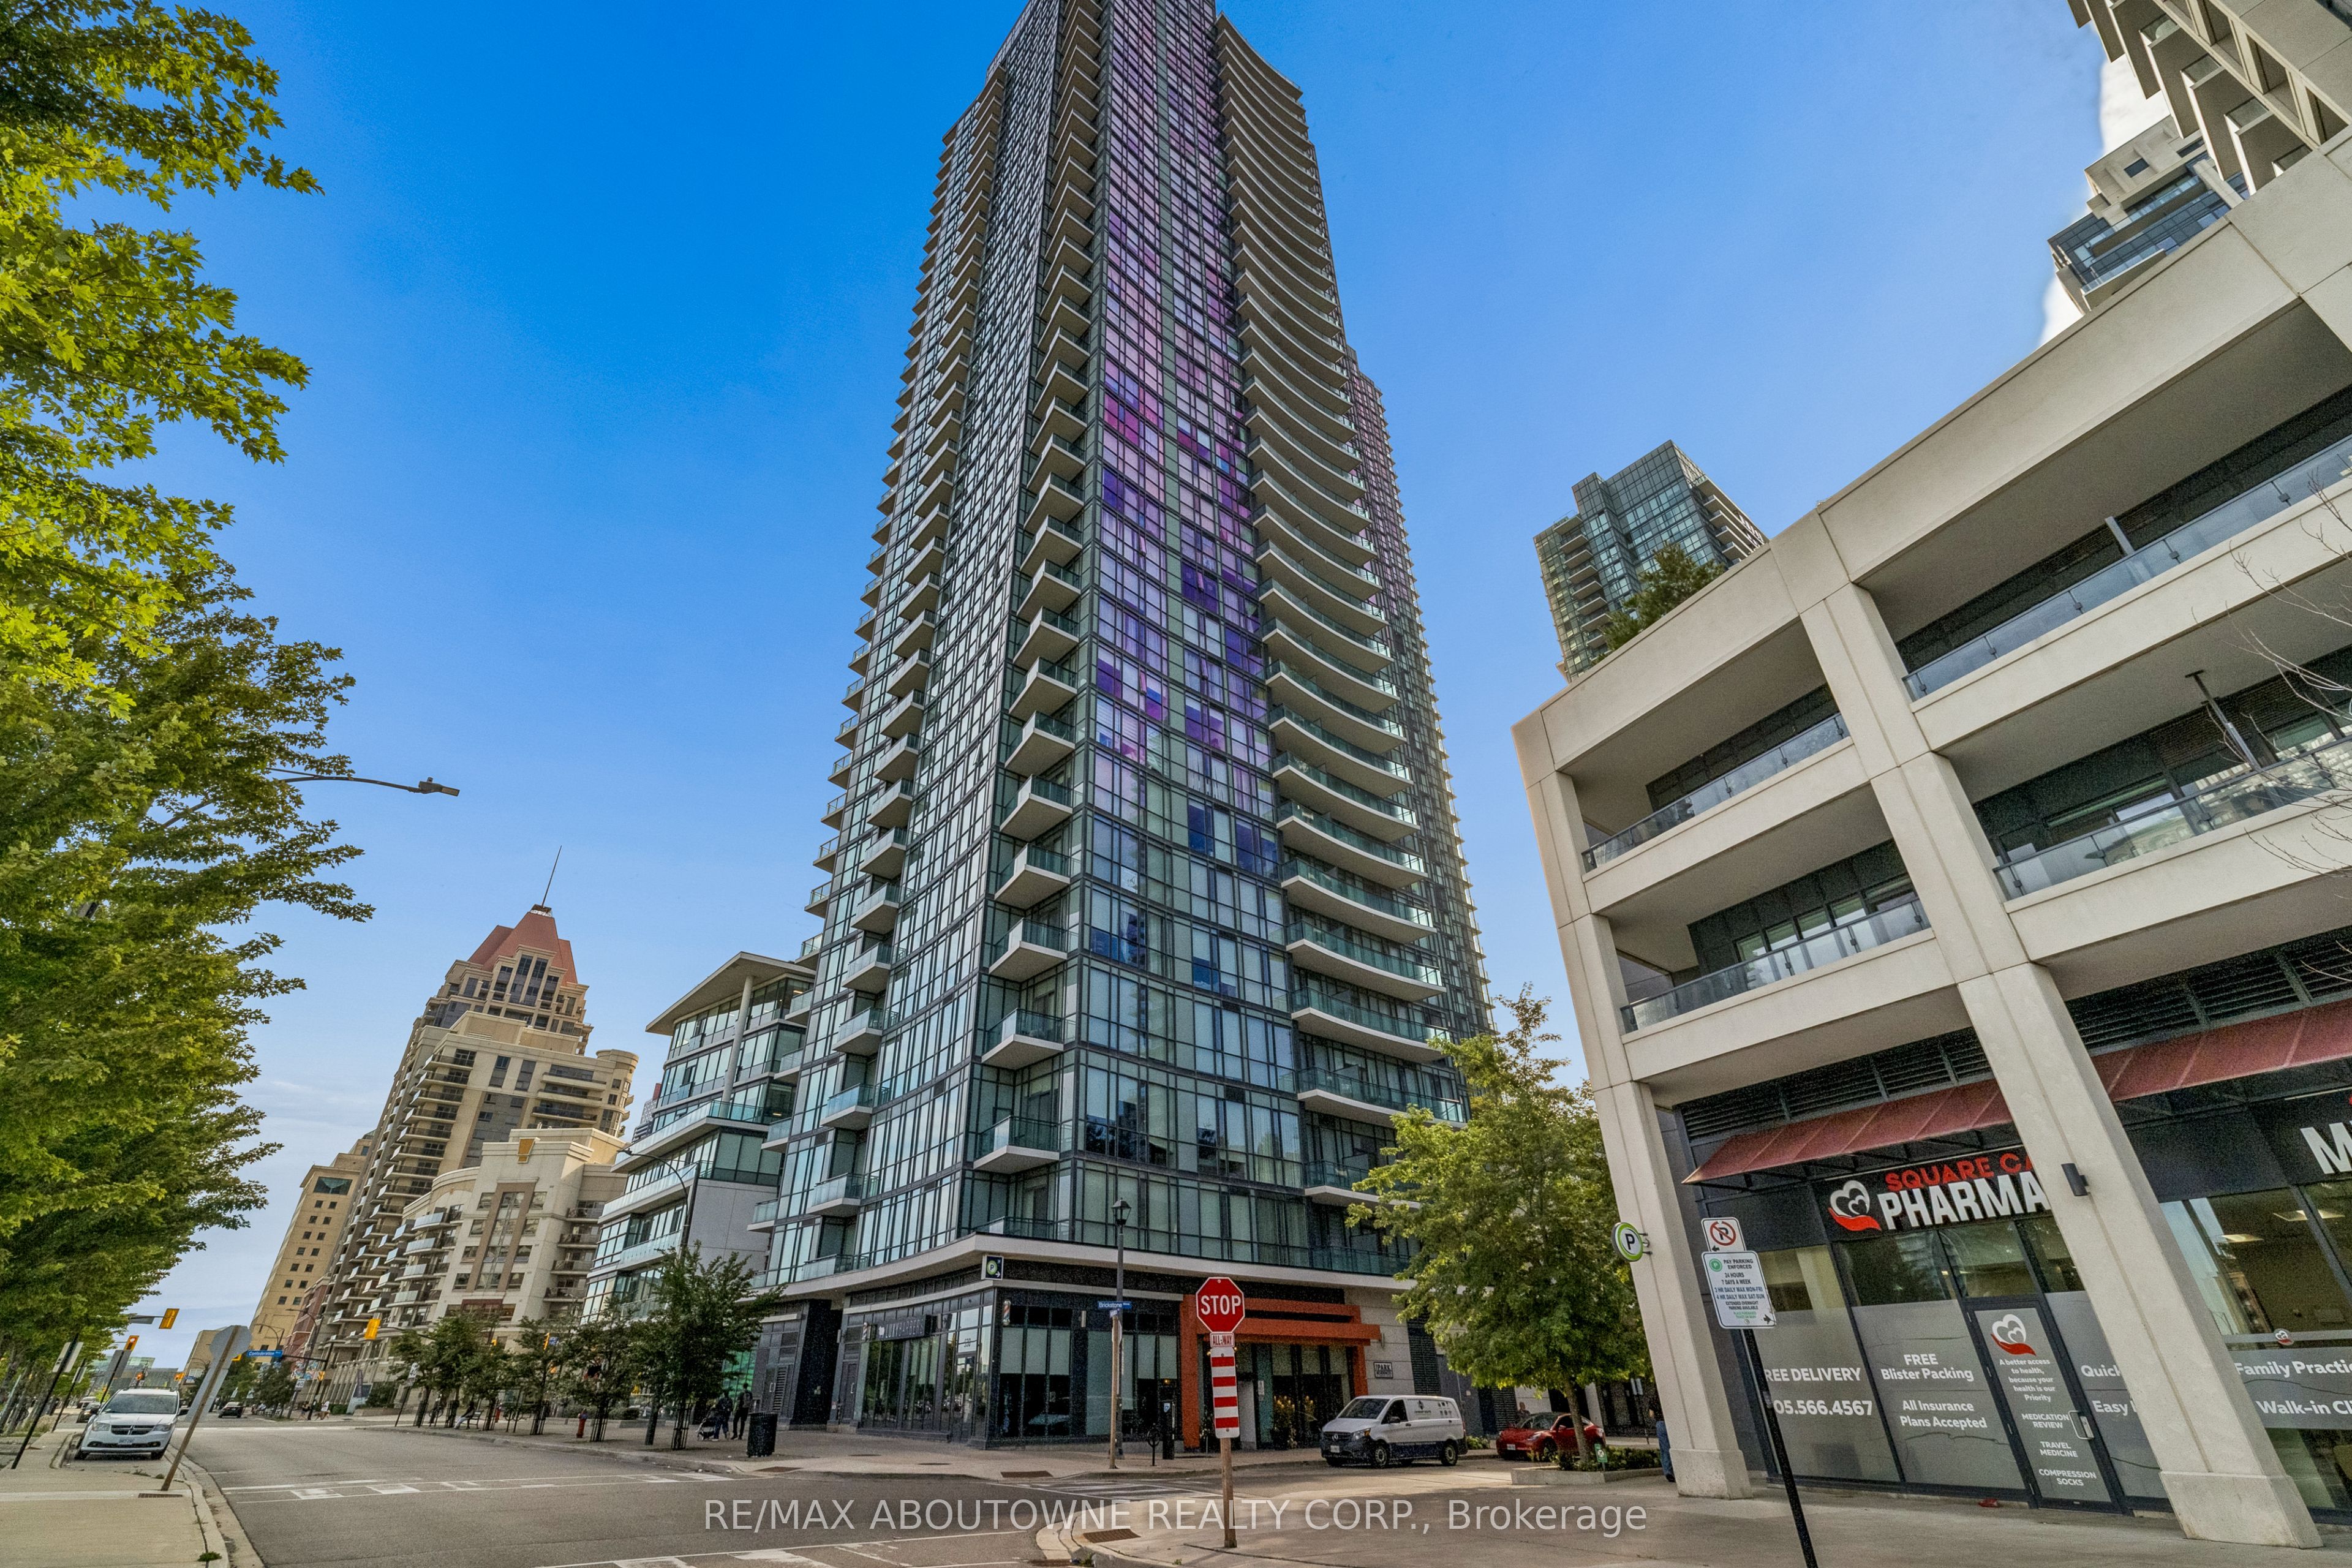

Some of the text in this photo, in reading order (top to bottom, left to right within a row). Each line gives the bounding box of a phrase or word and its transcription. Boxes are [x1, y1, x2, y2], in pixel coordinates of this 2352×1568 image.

[2300, 1122, 2352, 1174] M
[1885, 1156, 1994, 1191] SQUARE
[1877, 1171, 2051, 1230] PHARMA
[1625, 1234, 1635, 1250] P
[1200, 1295, 1242, 1315] STOP
[1213, 1335, 1232, 1345] ALL-WAY
[1904, 1354, 1939, 1365] FREE
[1764, 1367, 1861, 1382] REE DELIVERY
[1880, 1367, 1974, 1382] Blister Packing
[2234, 1361, 2290, 1378] Family
[1773, 1400, 1872, 1415] 05.566.4567
[1902, 1400, 1974, 1412] All Insurance
[2092, 1400, 2128, 1416] Easy
[2255, 1400, 2331, 1414] Walk-in
[1900, 1416, 1988, 1430] Plans Accepted
[2040, 1449, 2078, 1458] MEDICINE
[2038, 1469, 2097, 1479] COMPRESSION
